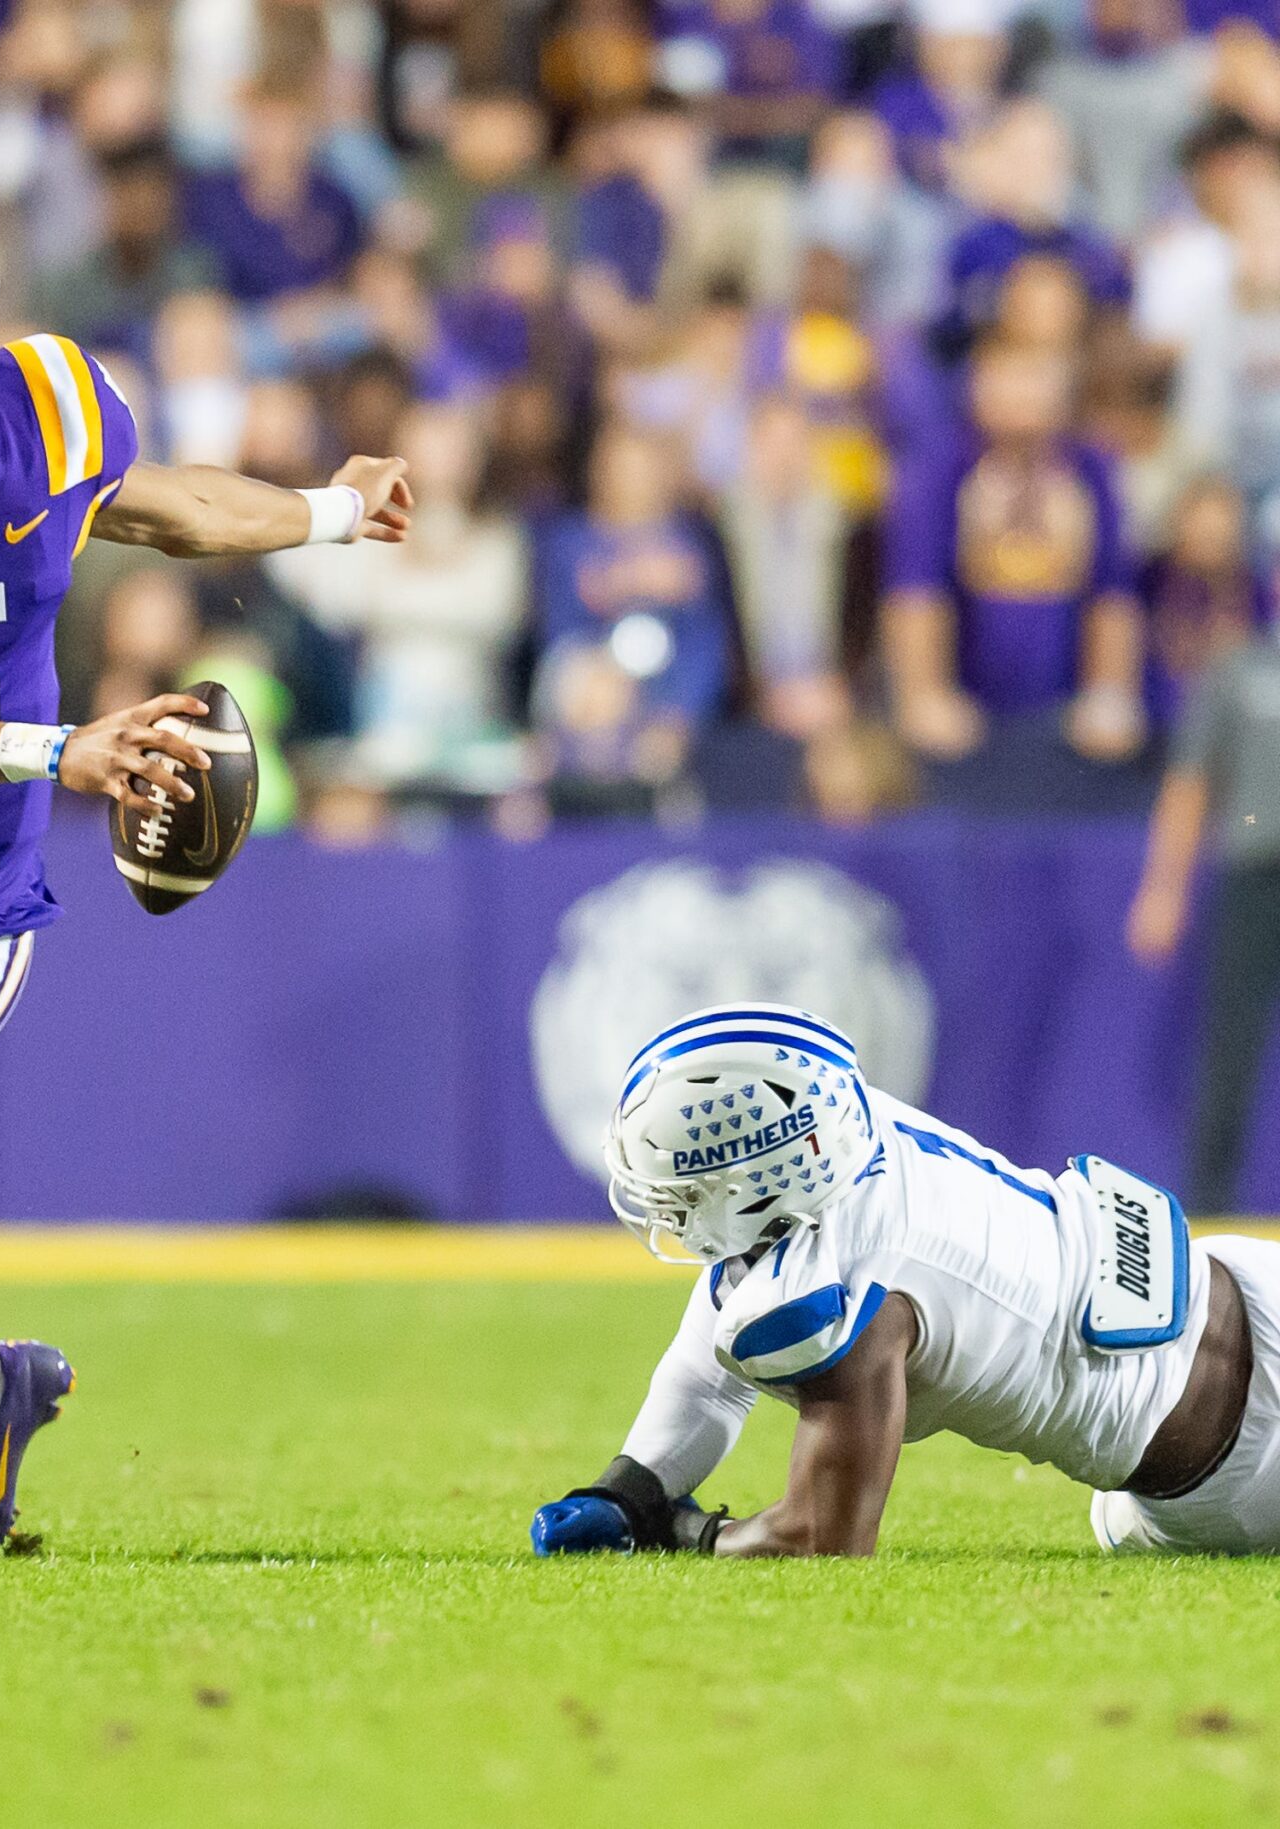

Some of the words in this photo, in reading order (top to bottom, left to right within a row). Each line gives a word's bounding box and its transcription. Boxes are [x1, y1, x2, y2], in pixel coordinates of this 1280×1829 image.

[673, 1103, 815, 1171] PANTHERS
[804, 1132, 821, 1157] 1
[1113, 1192, 1151, 1302] DOUGLAS
